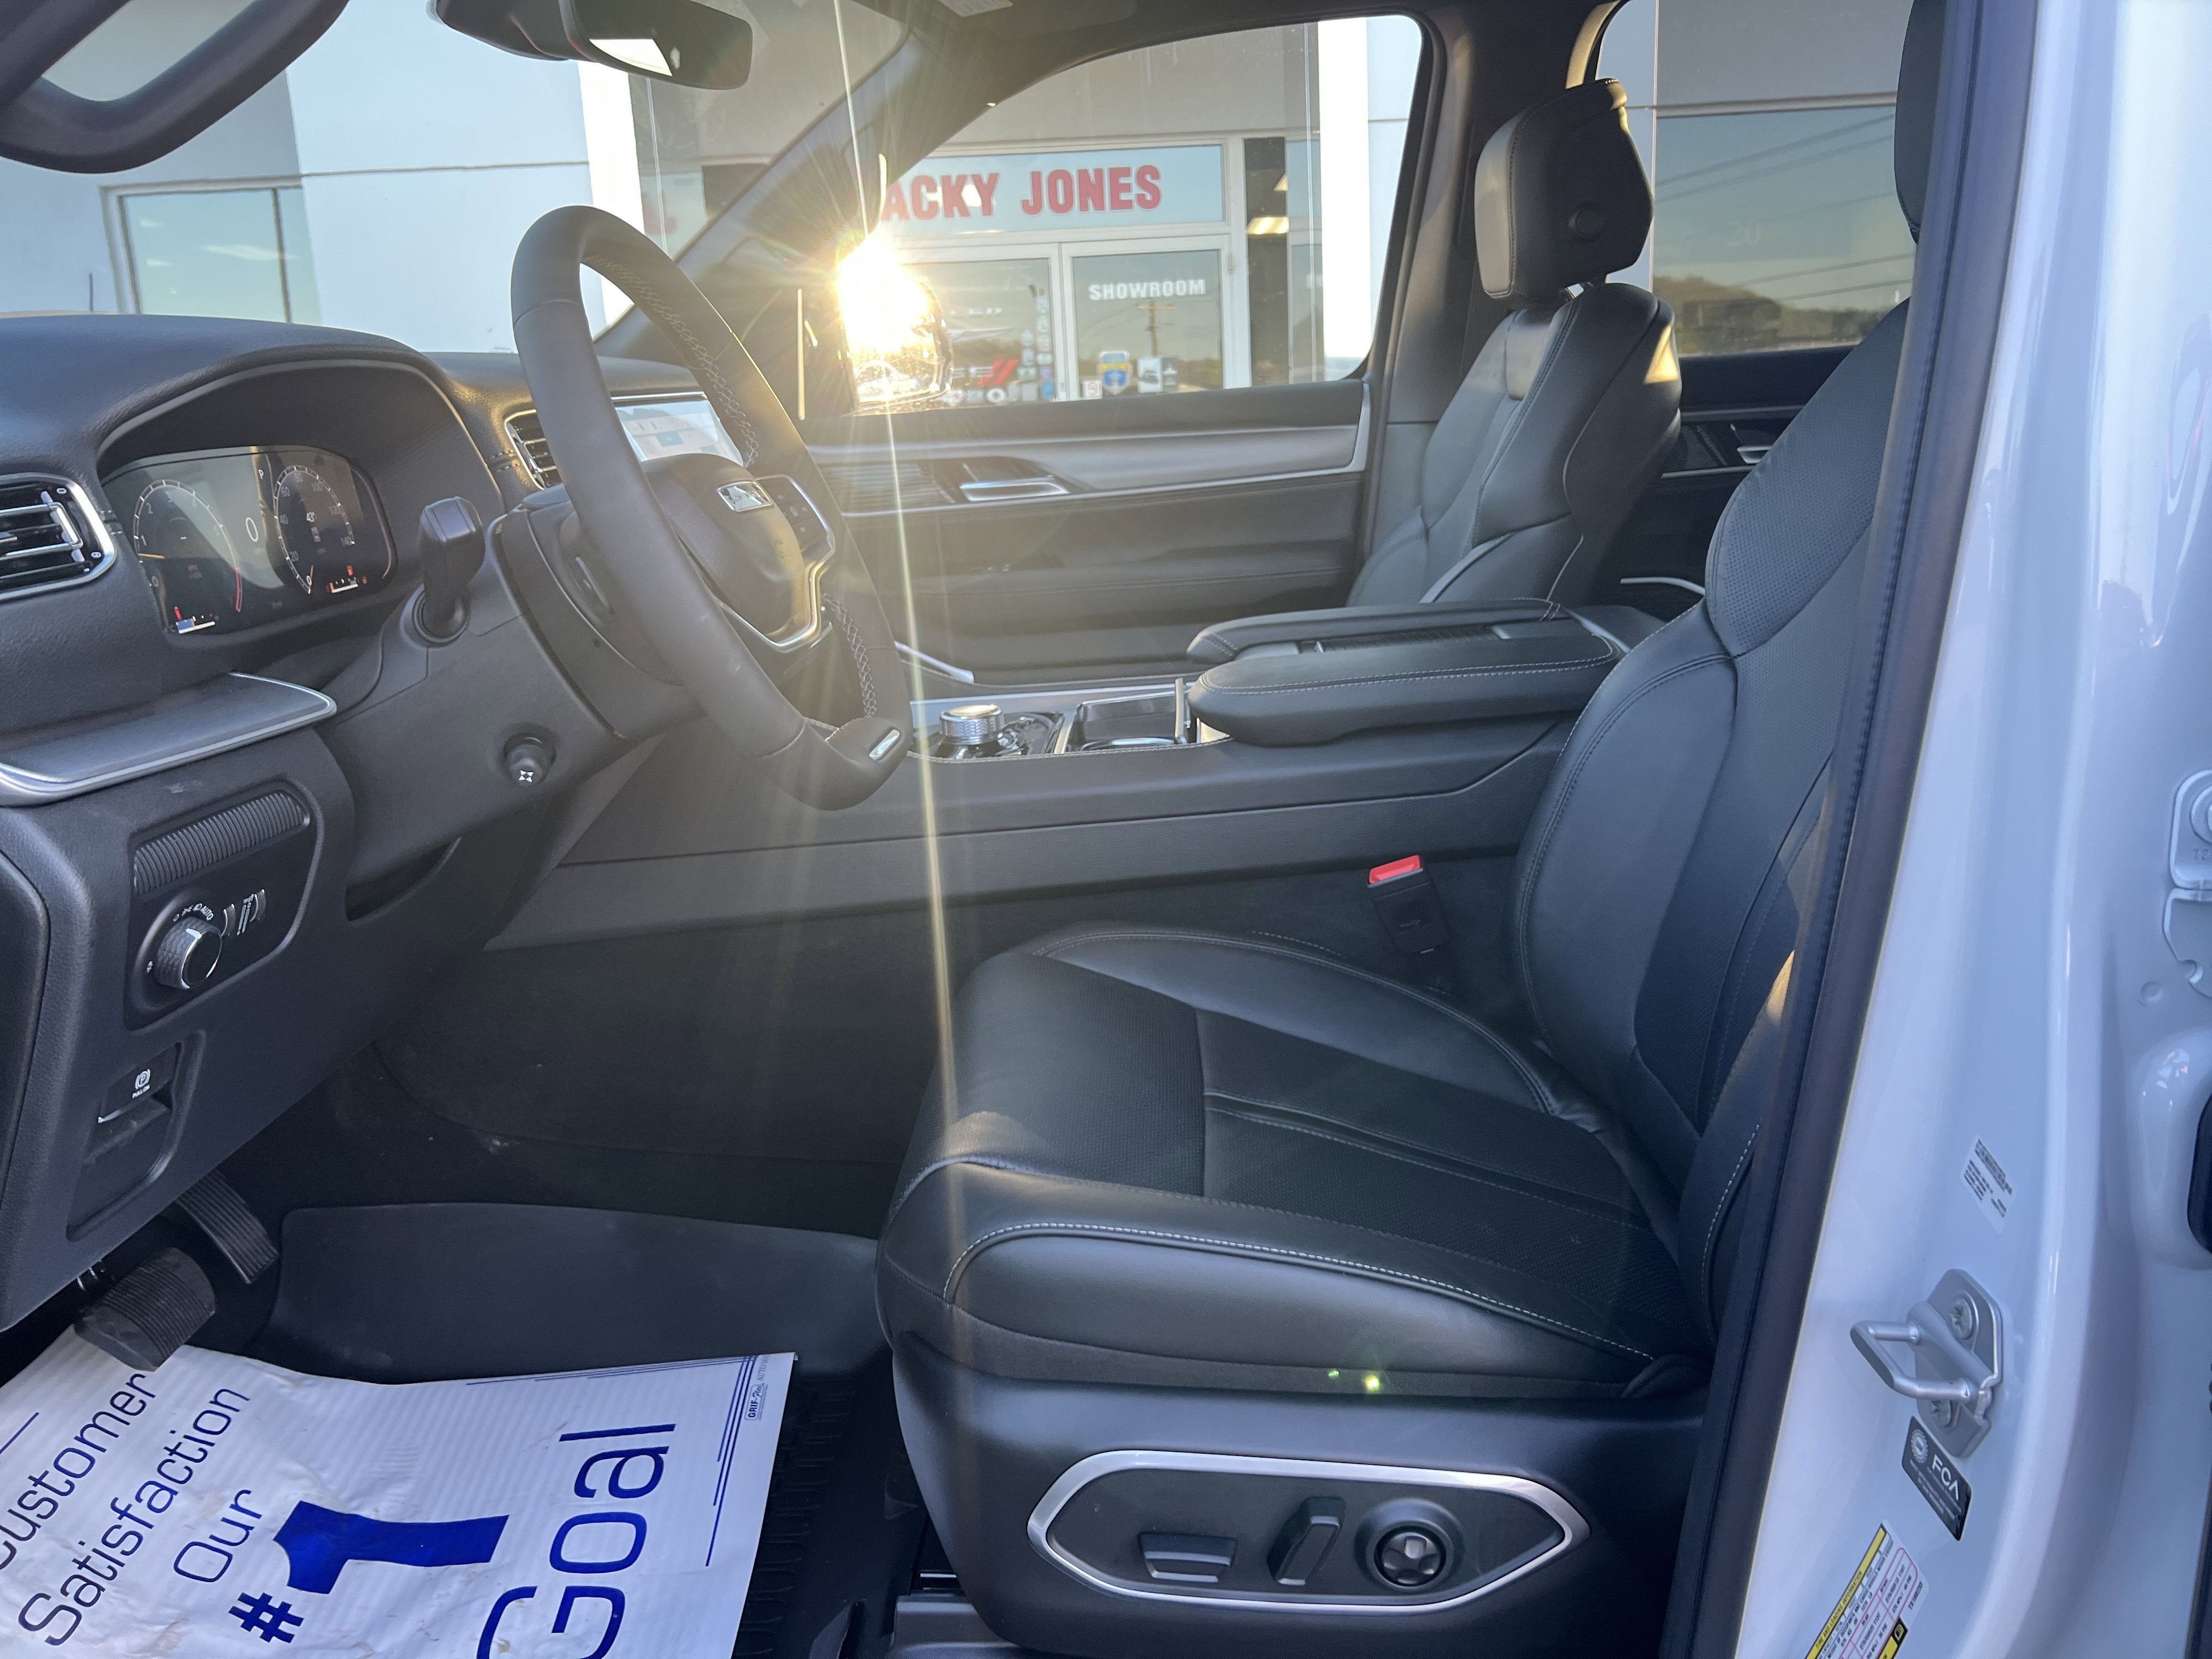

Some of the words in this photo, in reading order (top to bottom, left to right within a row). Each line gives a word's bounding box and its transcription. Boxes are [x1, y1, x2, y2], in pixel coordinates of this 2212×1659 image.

[881, 172, 1000, 221] ACKY
[1021, 165, 1163, 216] JONES
[1088, 279, 1206, 301] SHOWROOM
[1932, 1454, 1959, 1501] FCA
[18, 1388, 250, 1646] Satisfaction
[173, 1488, 262, 1583] Our
[476, 1423, 677, 1659] Goal
